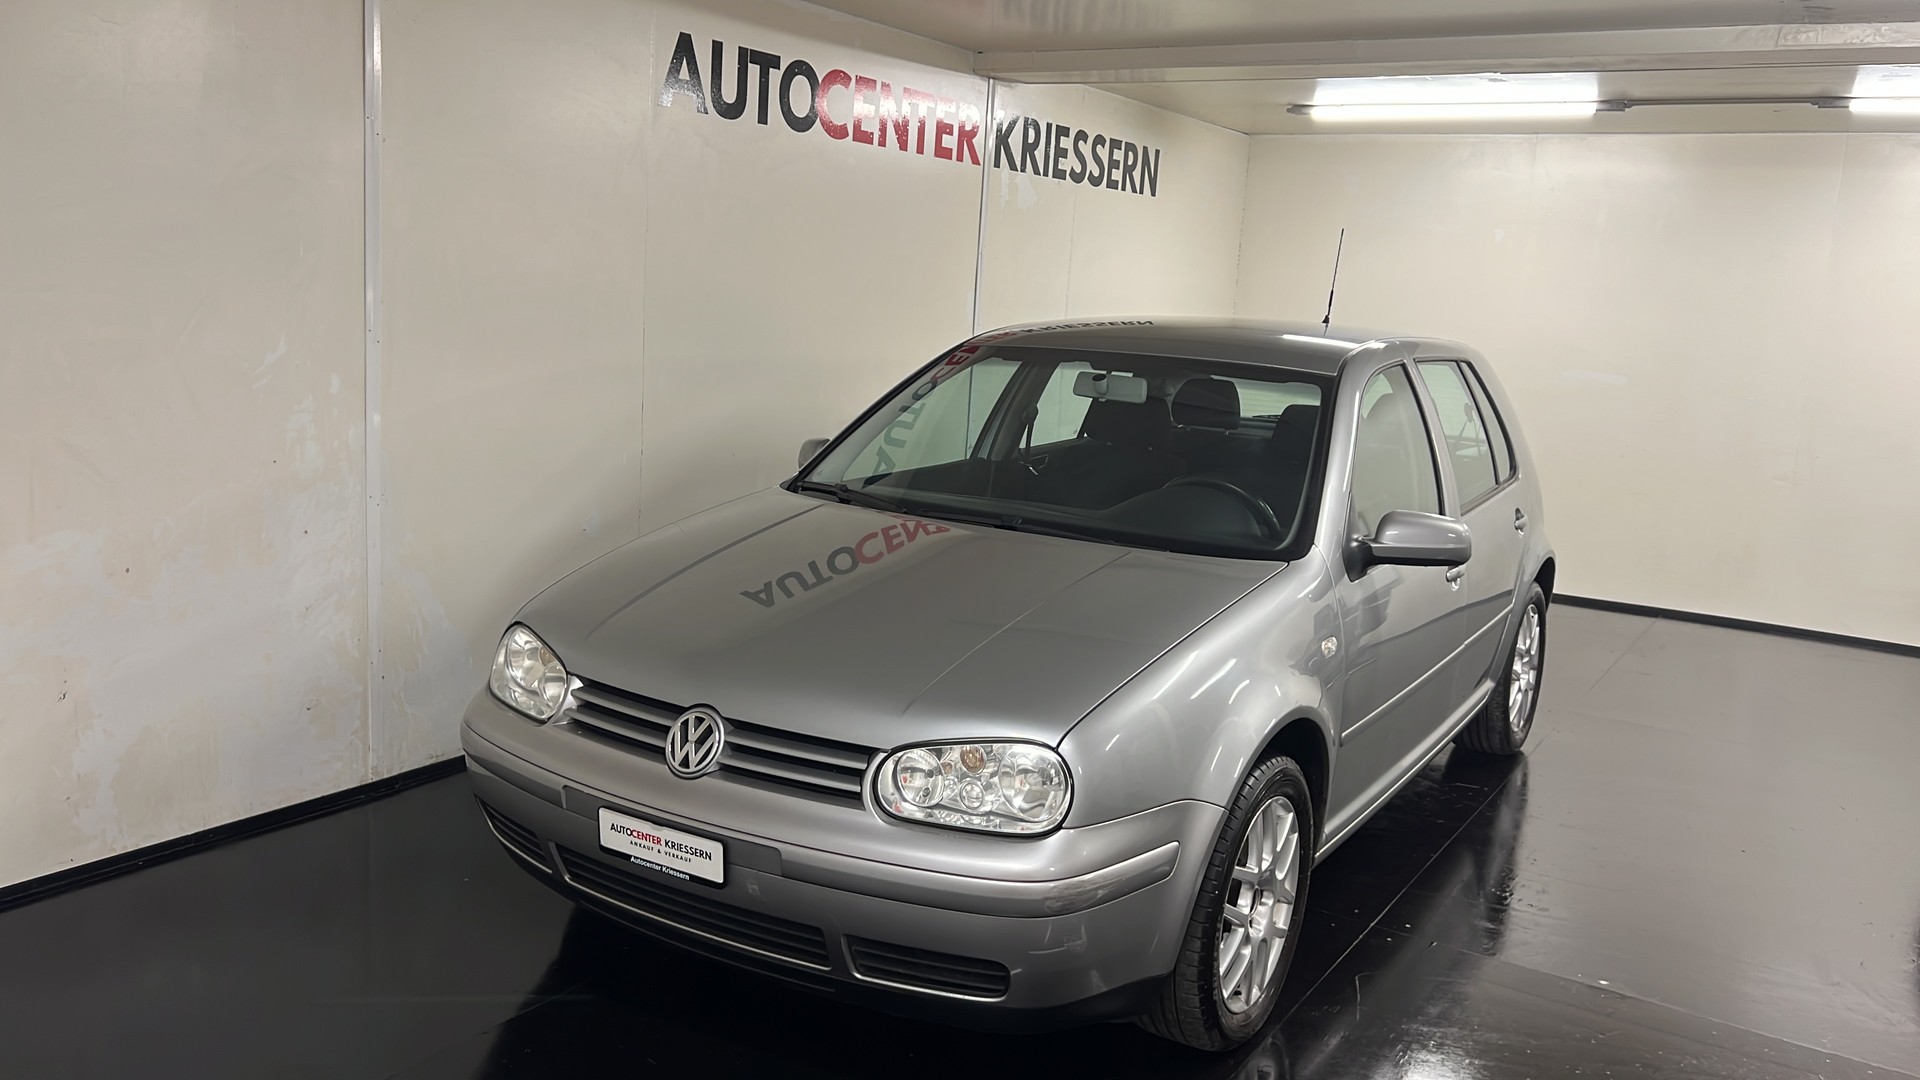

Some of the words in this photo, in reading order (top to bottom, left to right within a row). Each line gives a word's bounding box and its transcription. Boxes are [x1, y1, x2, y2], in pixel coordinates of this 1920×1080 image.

[658, 31, 981, 166] AUTOCENTER
[993, 109, 1161, 198] KRIESSERN
[669, 711, 719, 773] VW
[610, 822, 663, 847] AUTOCENTER
[664, 838, 712, 861] KRIESSERN
[629, 840, 655, 852] ANKAUF
[664, 850, 693, 863] VERKAUF
[630, 855, 662, 872] Autocenter
[662, 866, 690, 881] Kriessern
